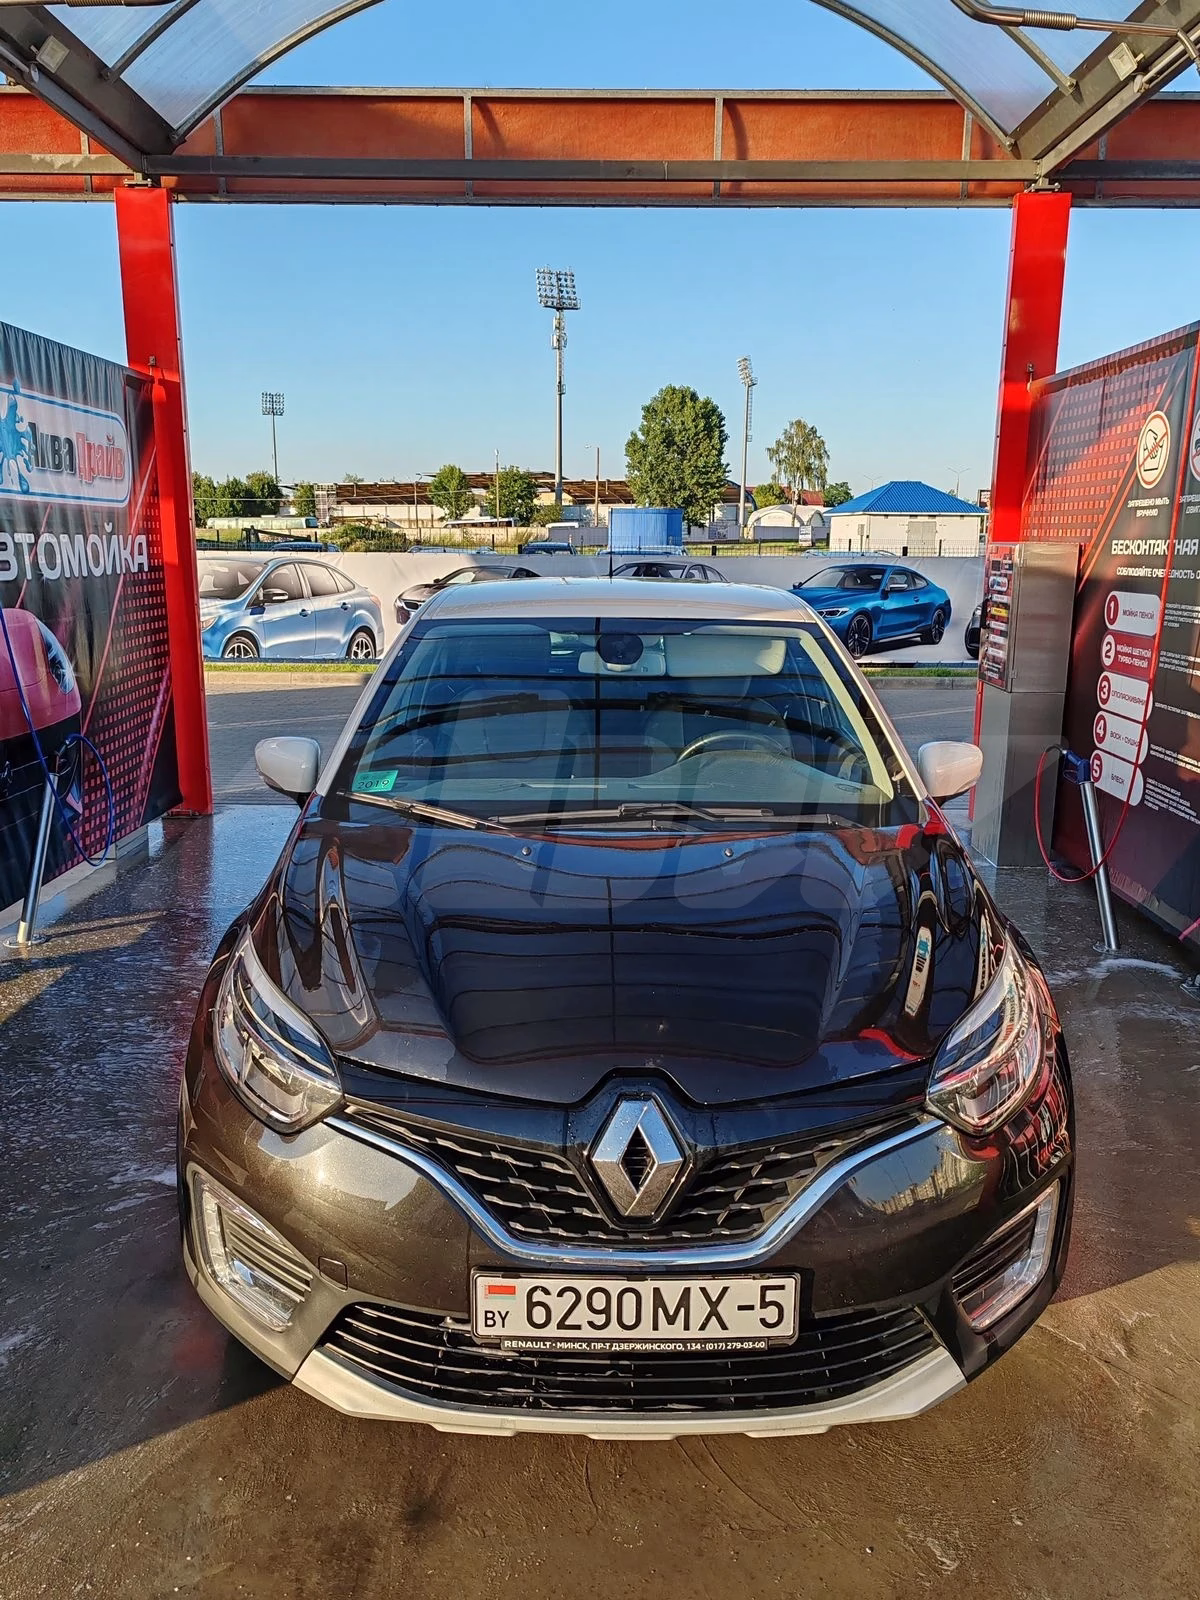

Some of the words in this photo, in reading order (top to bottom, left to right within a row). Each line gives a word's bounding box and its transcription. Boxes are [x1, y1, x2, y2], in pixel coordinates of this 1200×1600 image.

[1111, 538, 1199, 556] БЕСКОНТАКНАЯ
[1116, 565, 1152, 577] СОБЛЮДАЙТЕ
[1109, 600, 1115, 619] 1
[1122, 608, 1138, 618] МОЙКА
[1138, 610, 1155, 620] ПЕНОЙ
[1105, 641, 1113, 659] 2
[1100, 680, 1109, 700] 3
[1111, 689, 1146, 706] ОПОЛАСКИВАНИ
[1096, 719, 1104, 738] 4
[1109, 730, 1121, 741] ВОСК
[1124, 737, 1140, 748] СУШК
[1092, 760, 1101, 778] 5
[1110, 773, 1125, 785] БЛЕСК
[358, 779, 390, 788] 2019
[483, 1309, 511, 1329] BY
[504, 1340, 552, 1350] RENAULT
[556, 1341, 590, 1351] МИНСК,
[591, 1342, 610, 1351] ПР-Т
[611, 1342, 686, 1352] ДЗЕРЖИНСКОГО,
[686, 1342, 702, 1351] 134
[705, 1341, 726, 1351] (017)
